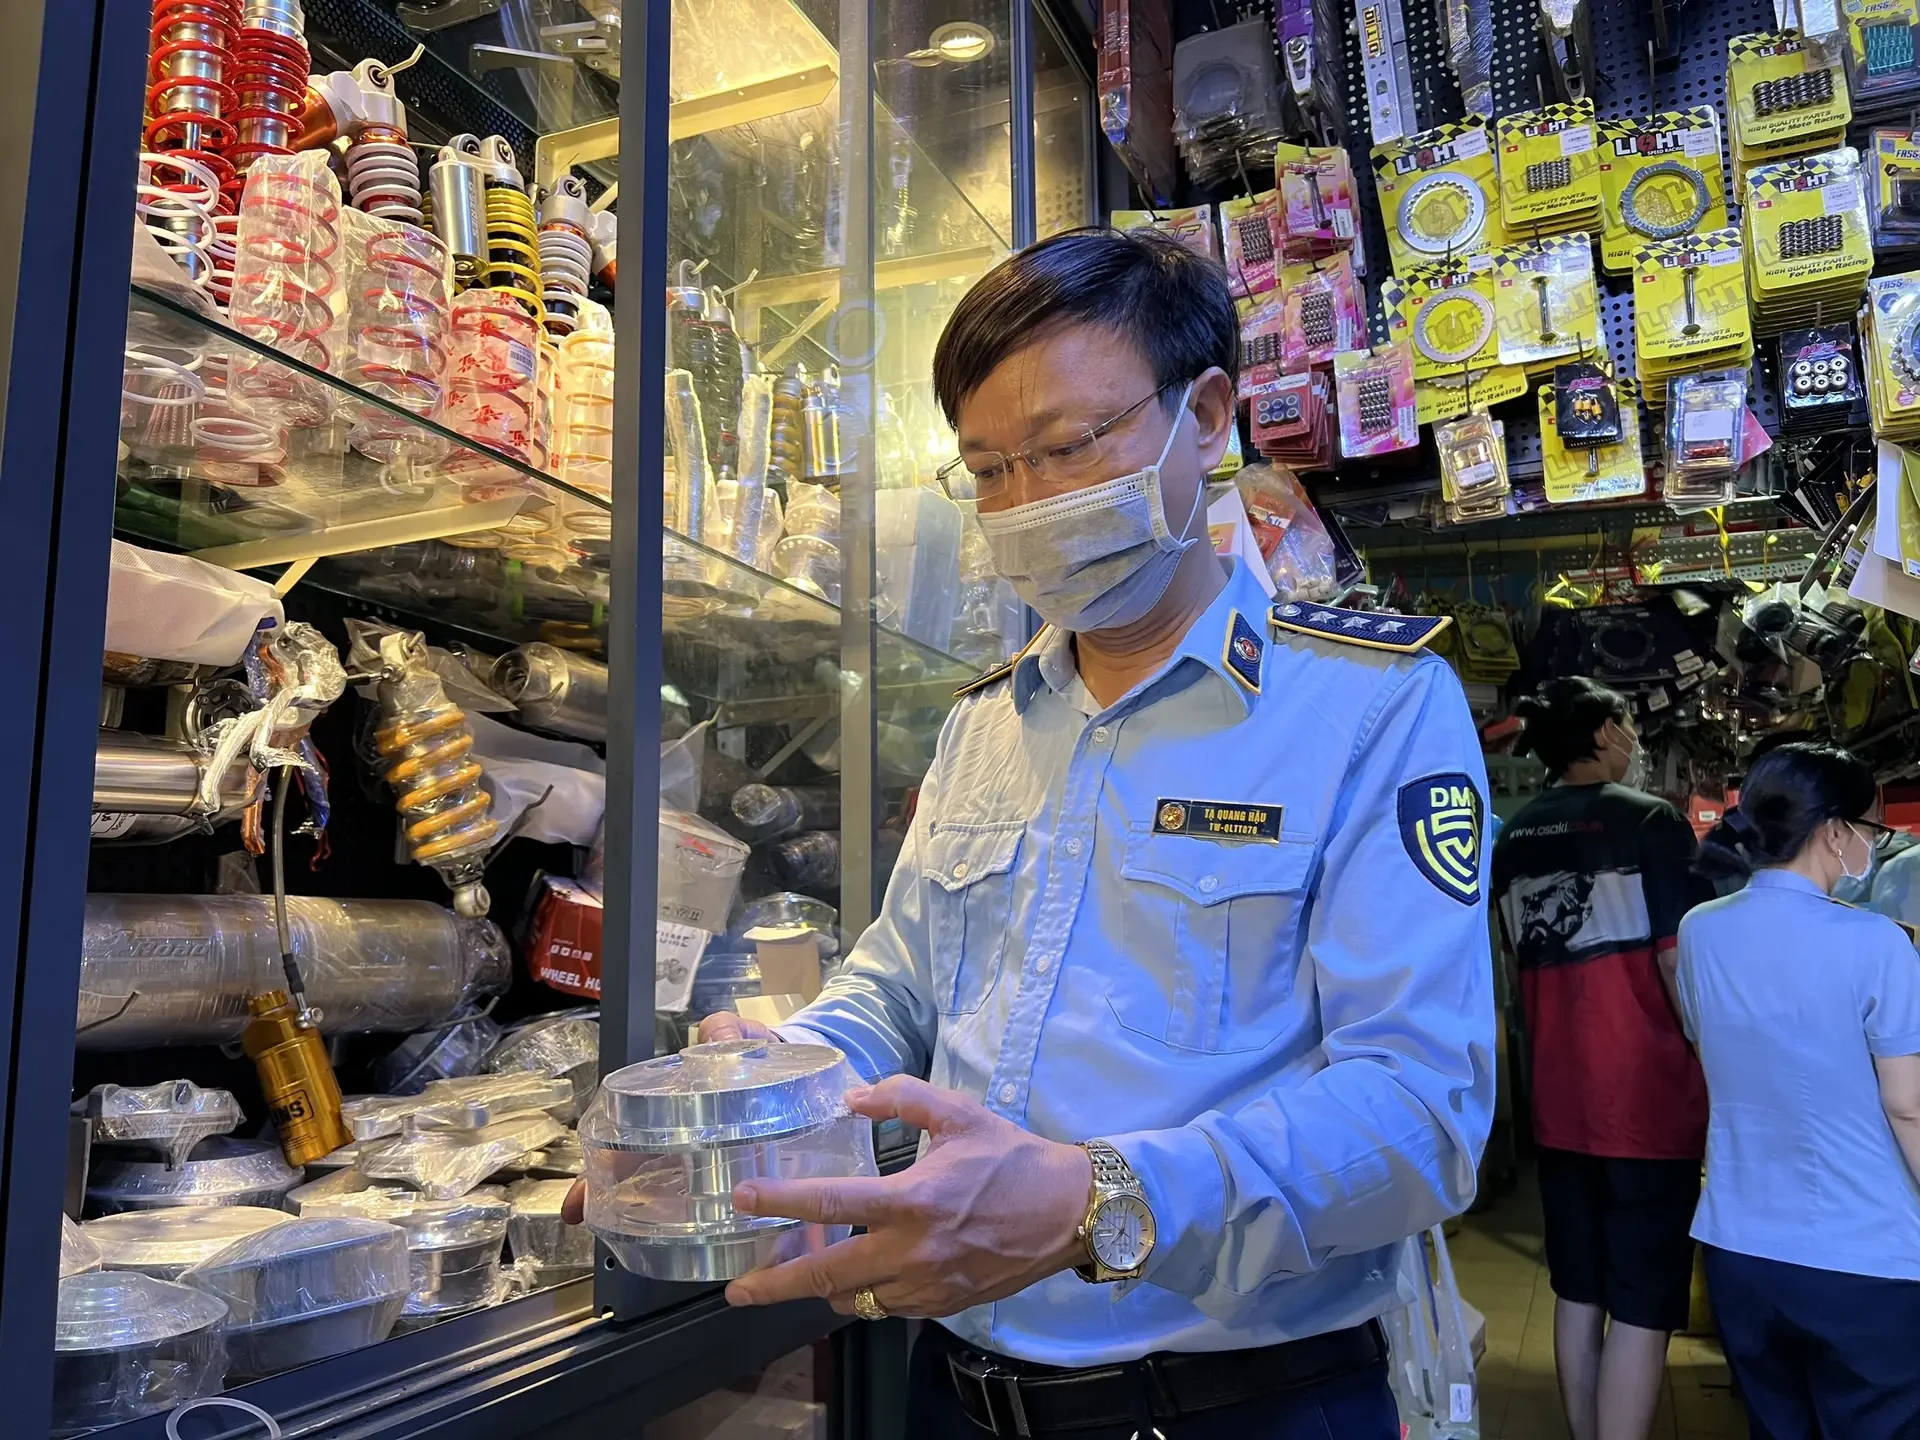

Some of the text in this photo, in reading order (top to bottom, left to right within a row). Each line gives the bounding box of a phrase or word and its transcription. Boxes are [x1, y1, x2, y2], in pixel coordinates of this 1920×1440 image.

[1760, 42, 1799, 57] LIGH
[1525, 120, 1568, 137] LIGHT
[1748, 110, 1831, 133] HIGH QUALITY PARTS
[1770, 114, 1845, 134] For Moto Racing
[1779, 173, 1829, 193] LIGHT
[1530, 198, 1558, 208] QUALITY
[1530, 194, 1598, 213] For Moto Racing
[1608, 250, 1631, 258] HIGH
[1765, 255, 1854, 276] HIGH QUALITY PARTS
[1789, 258, 1869, 279] For Moto Racing
[1669, 331, 1744, 349] For Moto Racing
[1475, 383, 1504, 397] PARTS
[1437, 404, 1454, 415] For
[1487, 385, 1522, 402] Racing
[1204, 808, 1267, 824] TẠ QUANG HẬU
[540, 967, 601, 991] WHEEL HU
